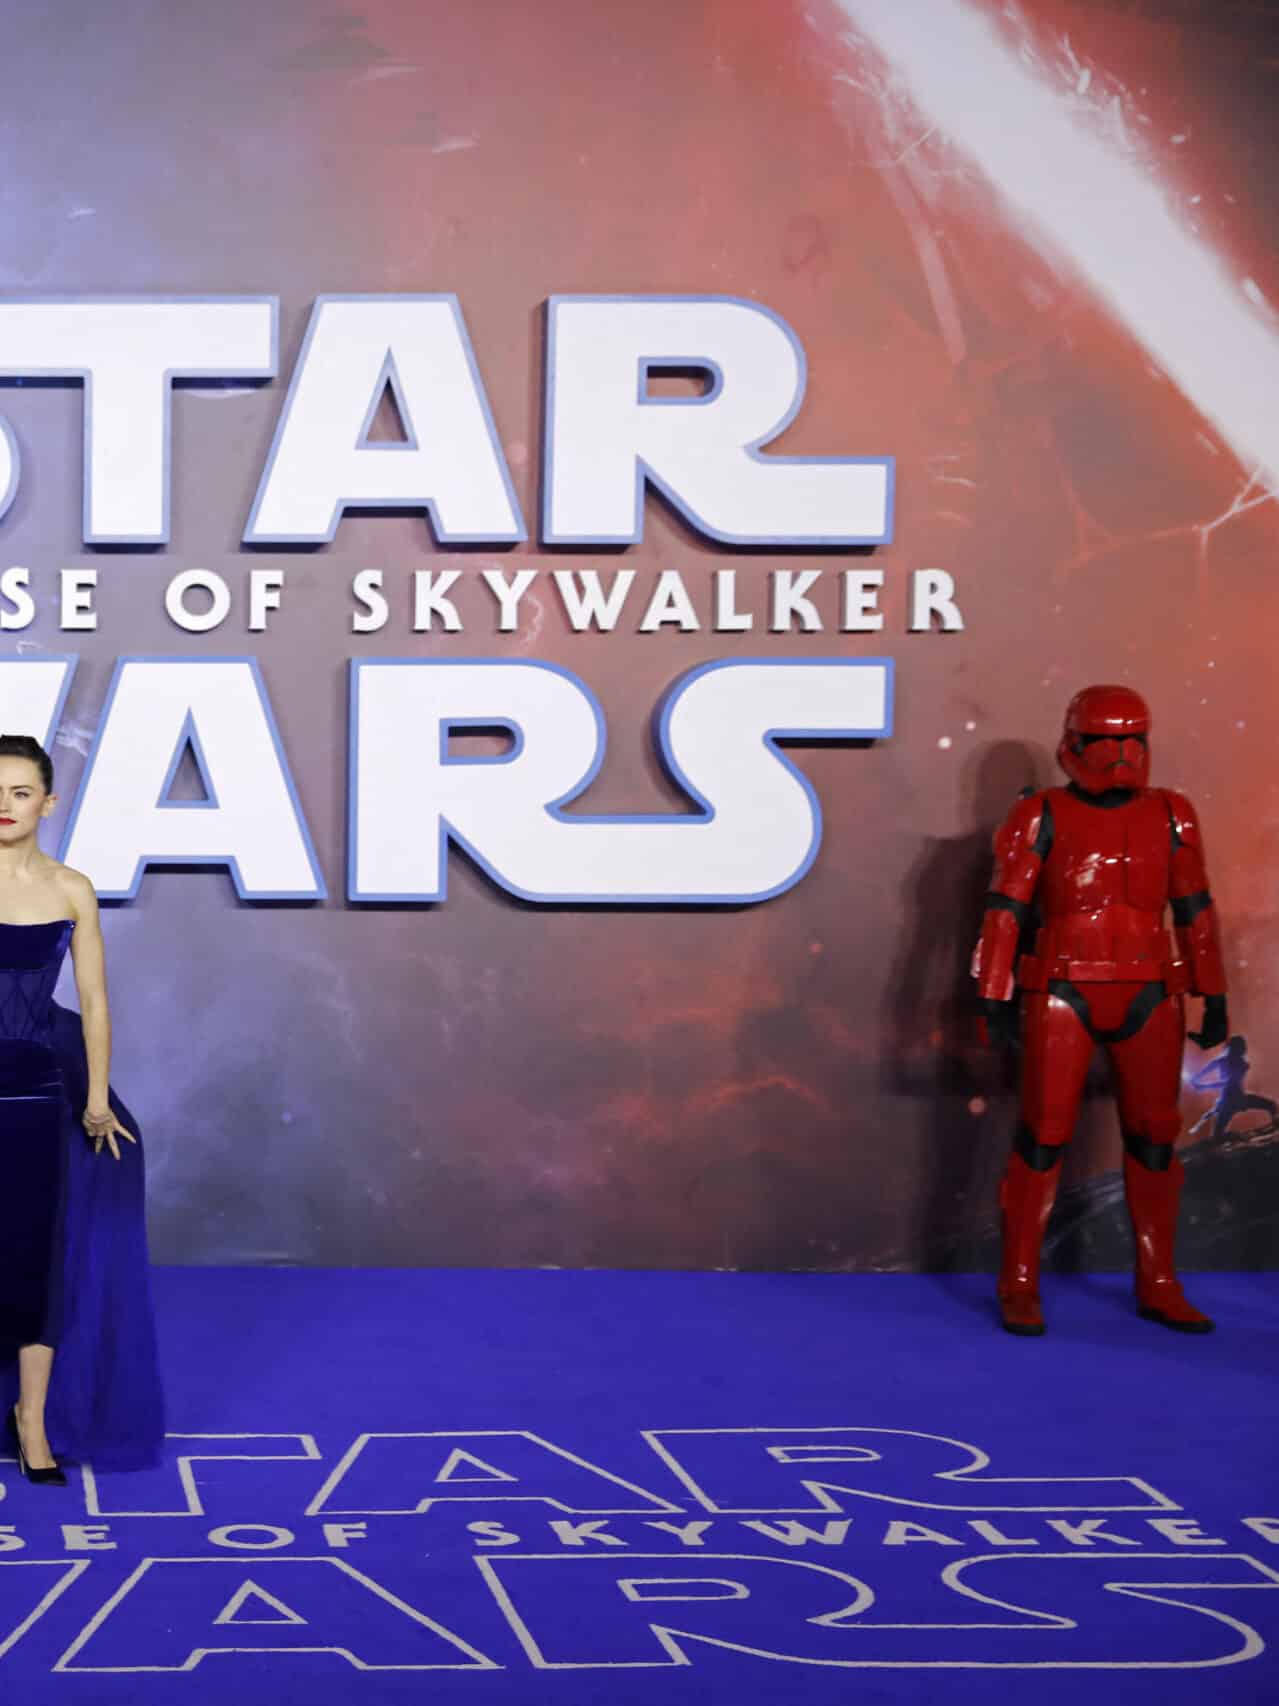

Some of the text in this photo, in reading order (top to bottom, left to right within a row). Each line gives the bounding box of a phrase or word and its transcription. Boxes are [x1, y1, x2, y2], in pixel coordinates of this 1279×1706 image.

[165, 568, 284, 631] OF
[351, 568, 965, 633] SKYWALKER
[207, 1521, 372, 1548] OF
